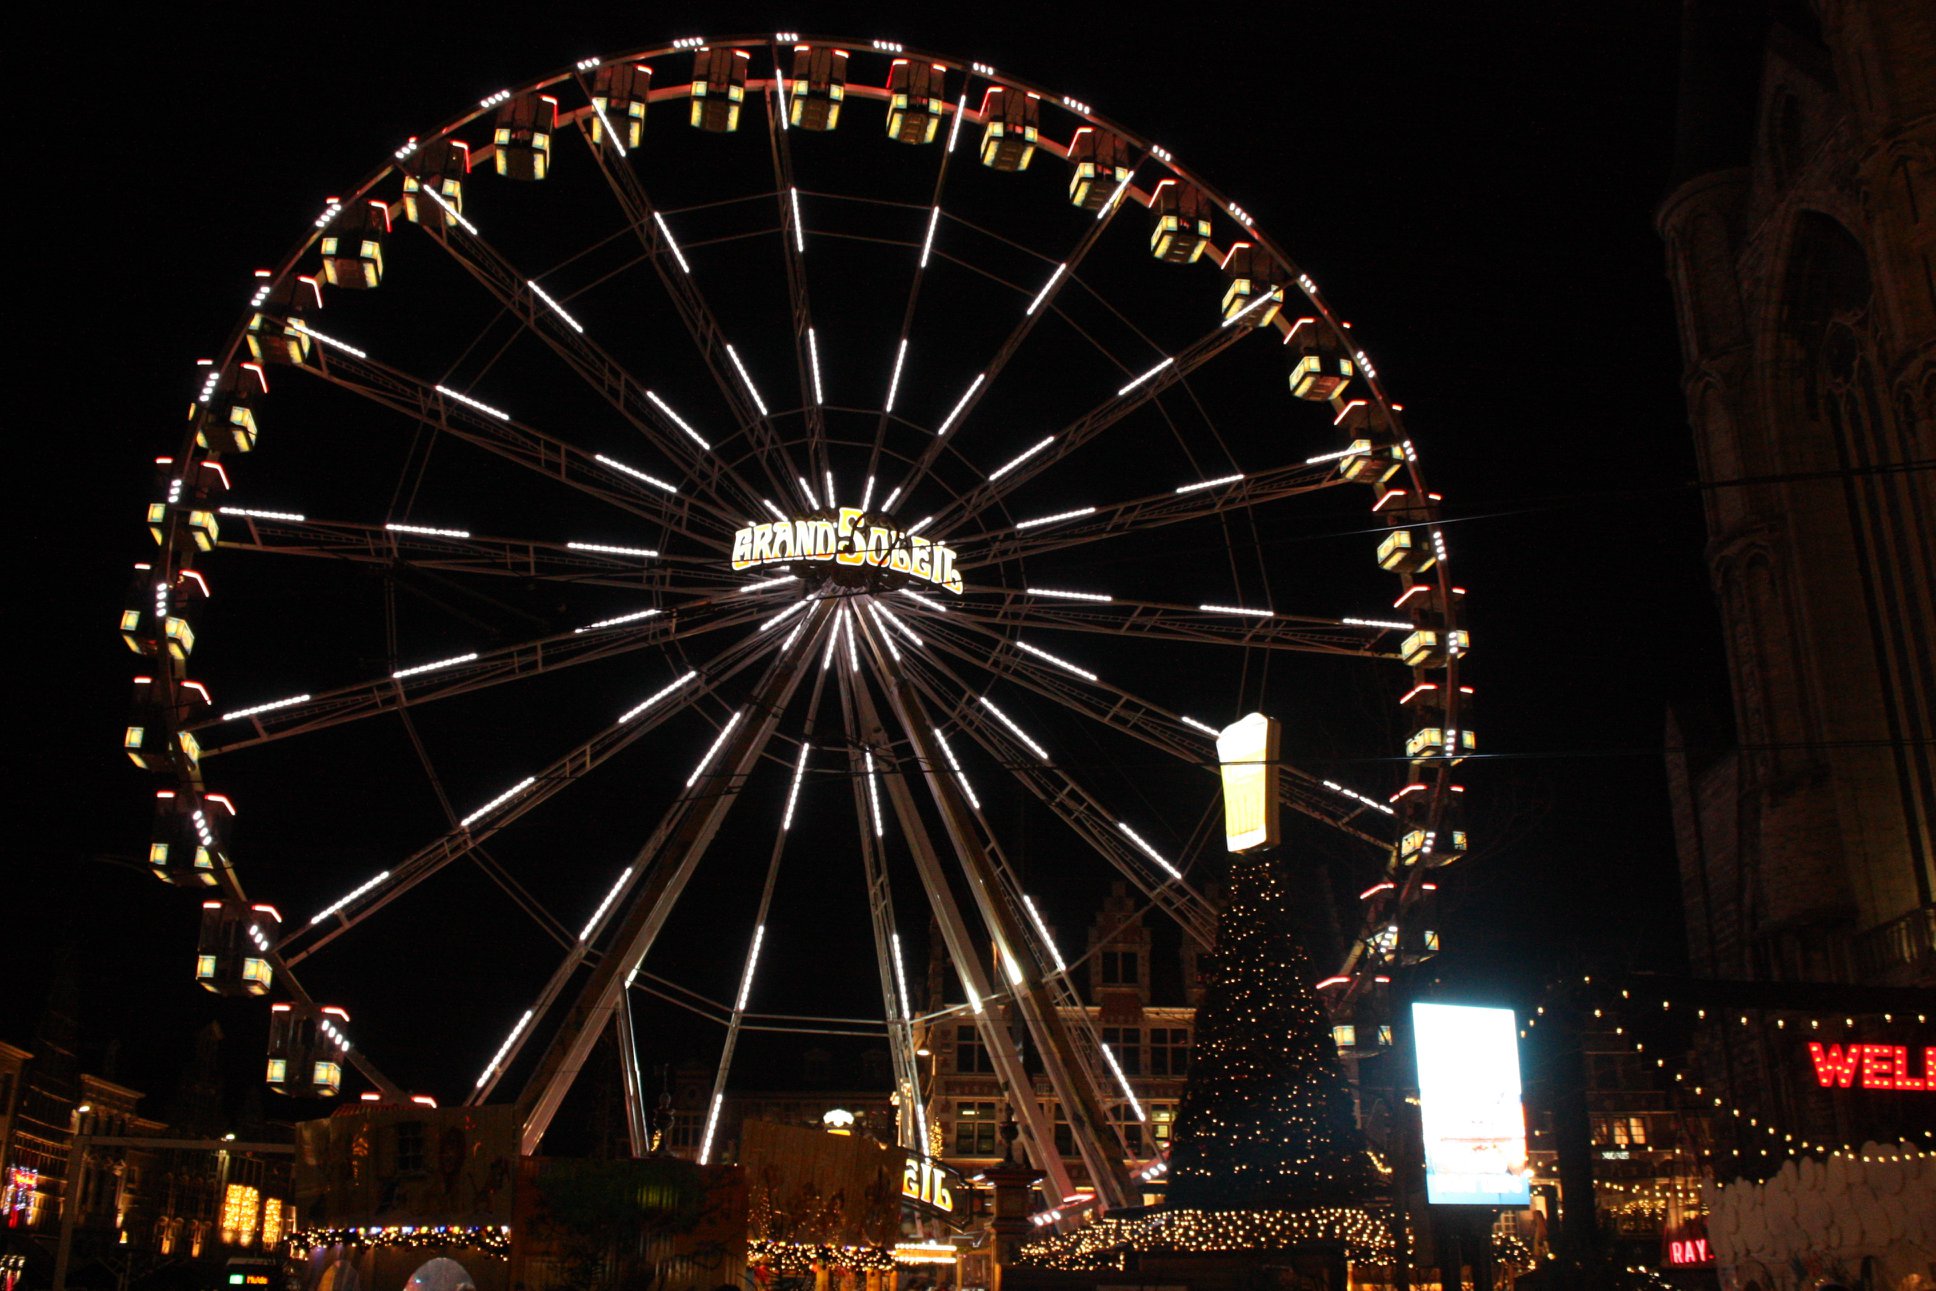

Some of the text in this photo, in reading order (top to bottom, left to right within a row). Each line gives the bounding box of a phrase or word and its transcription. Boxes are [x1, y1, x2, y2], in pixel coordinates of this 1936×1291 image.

[732, 507, 963, 595] GRAND SOLEIL
[902, 1158, 953, 1212] EIL
[1669, 1238, 1714, 1264] RAY
